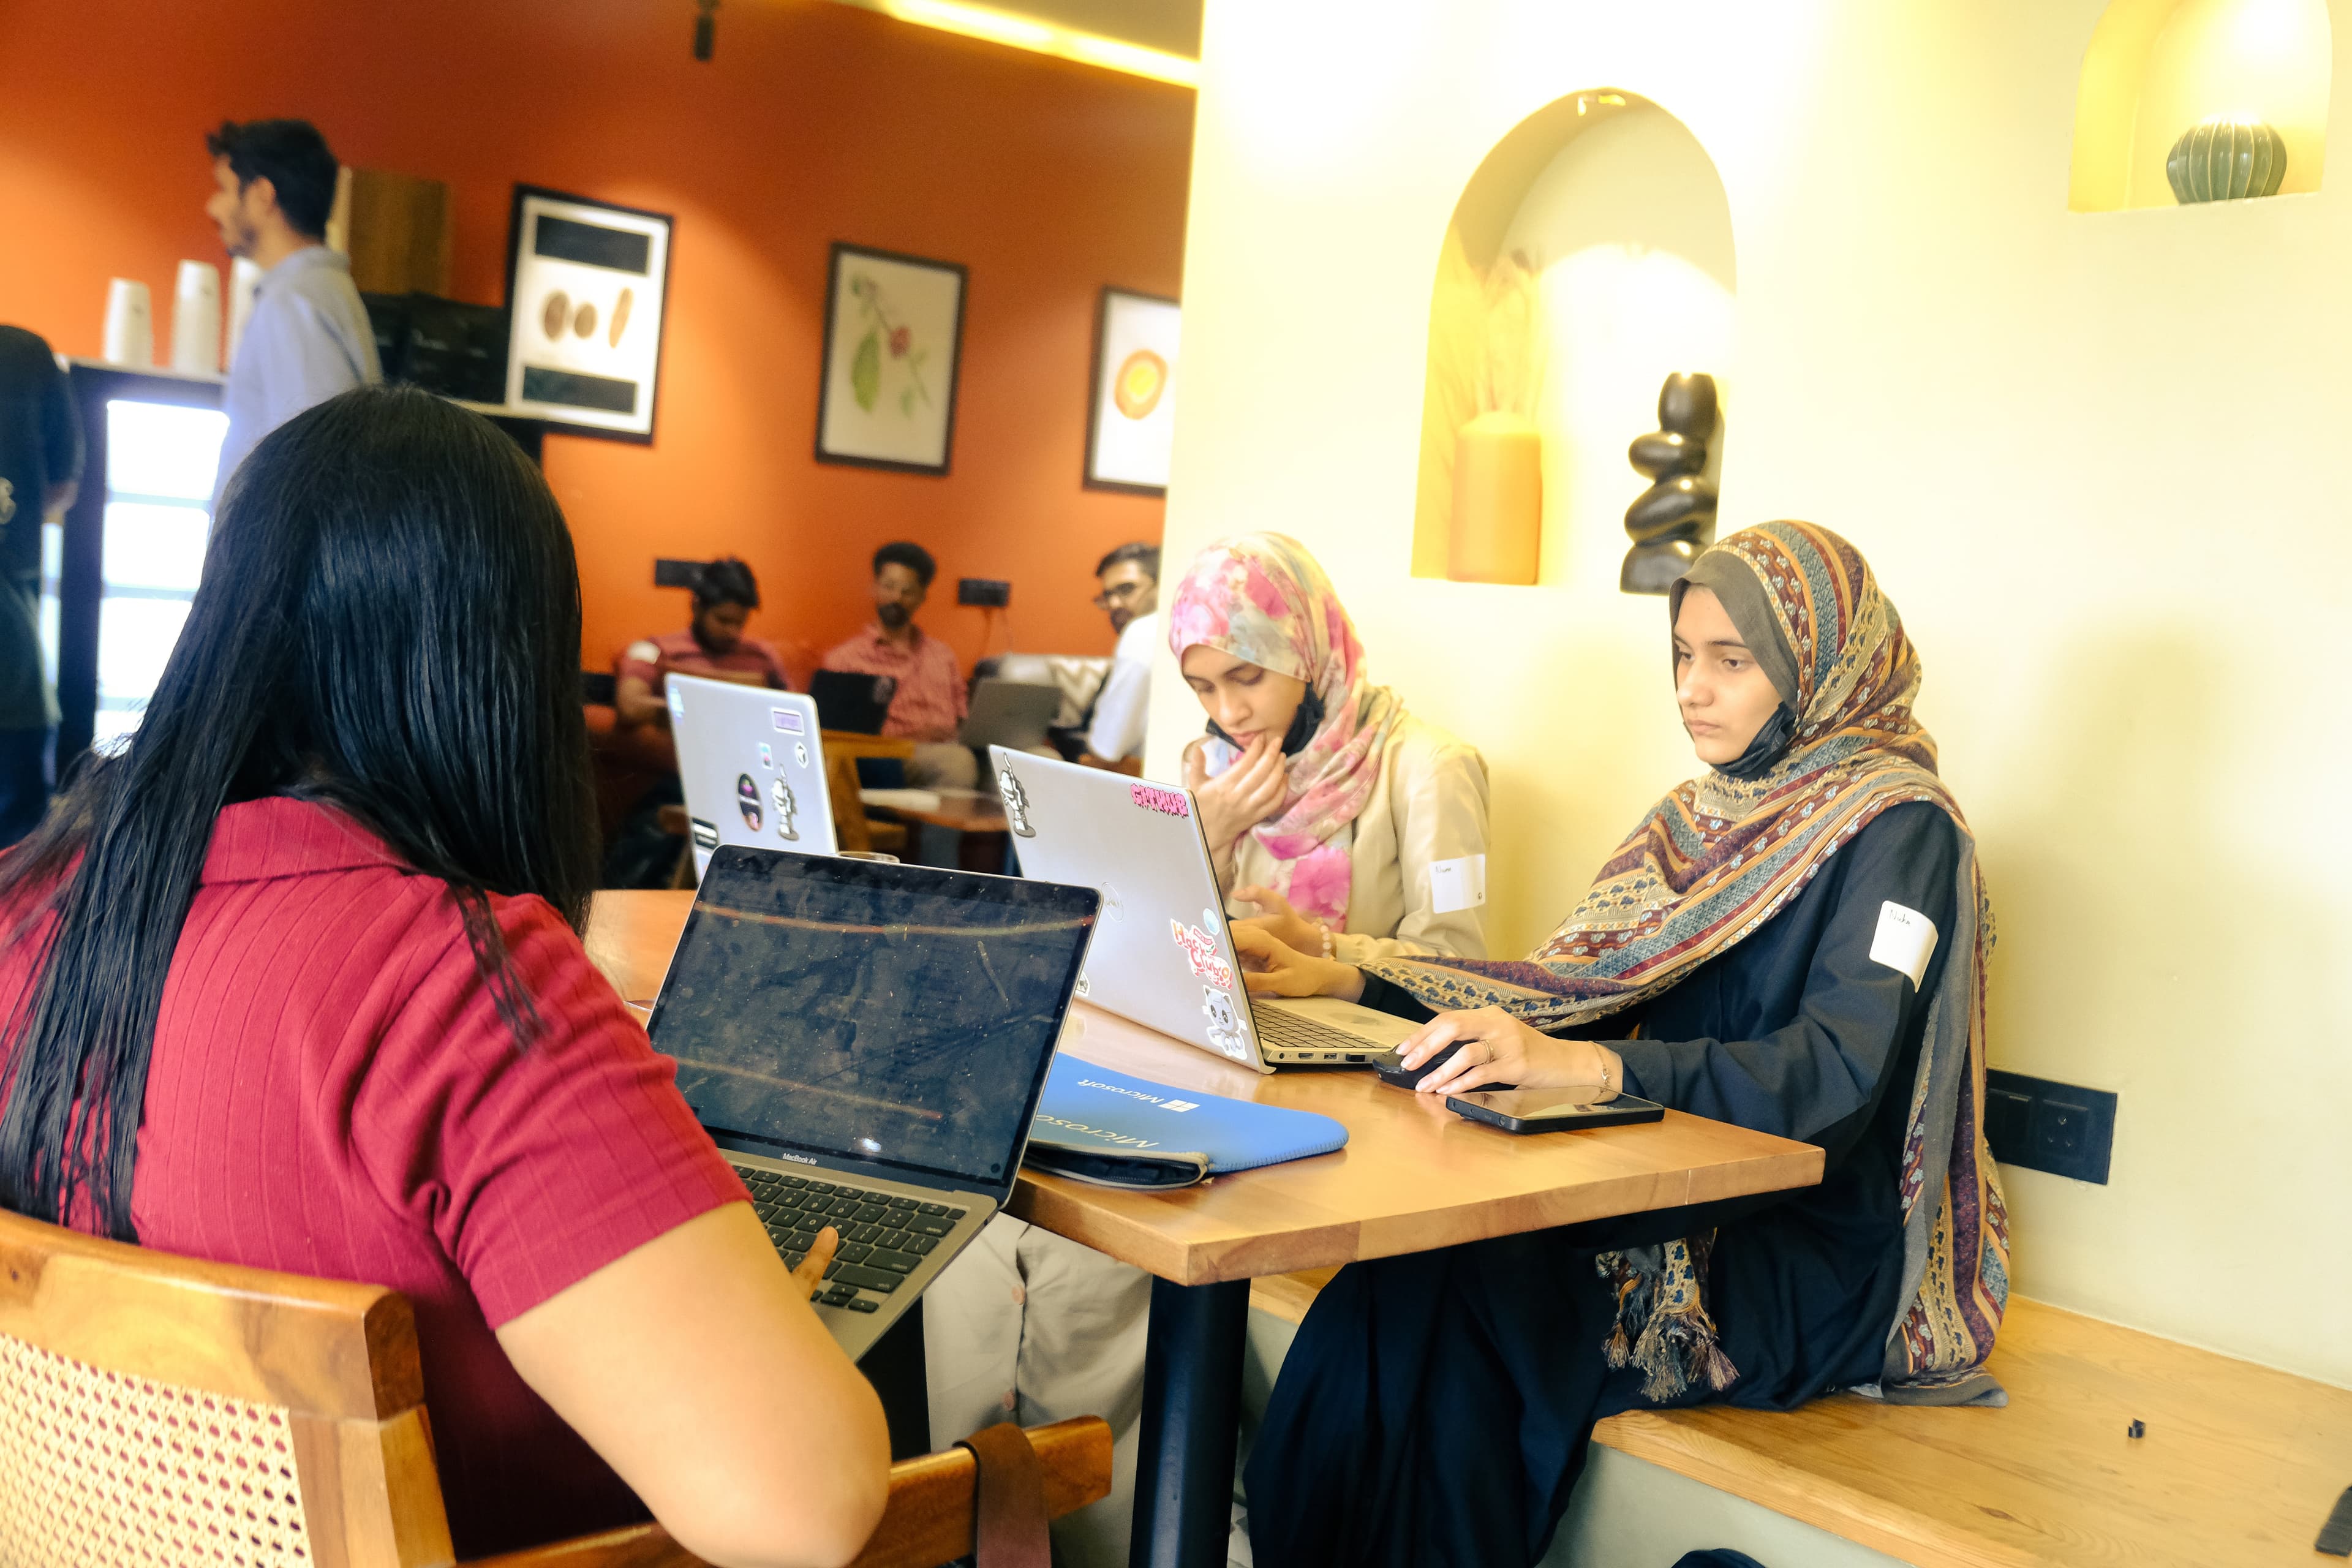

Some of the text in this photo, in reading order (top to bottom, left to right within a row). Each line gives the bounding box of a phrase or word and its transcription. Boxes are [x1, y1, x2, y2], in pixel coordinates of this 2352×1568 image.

[1130, 783, 1189, 819] GITHUB
[1172, 921, 1207, 957] Hack
[1190, 948, 1220, 978] Club
[1077, 1079, 1165, 1103] Microsoft
[1036, 1115, 1159, 1148] Microso
[783, 1153, 809, 1164] MacBook
